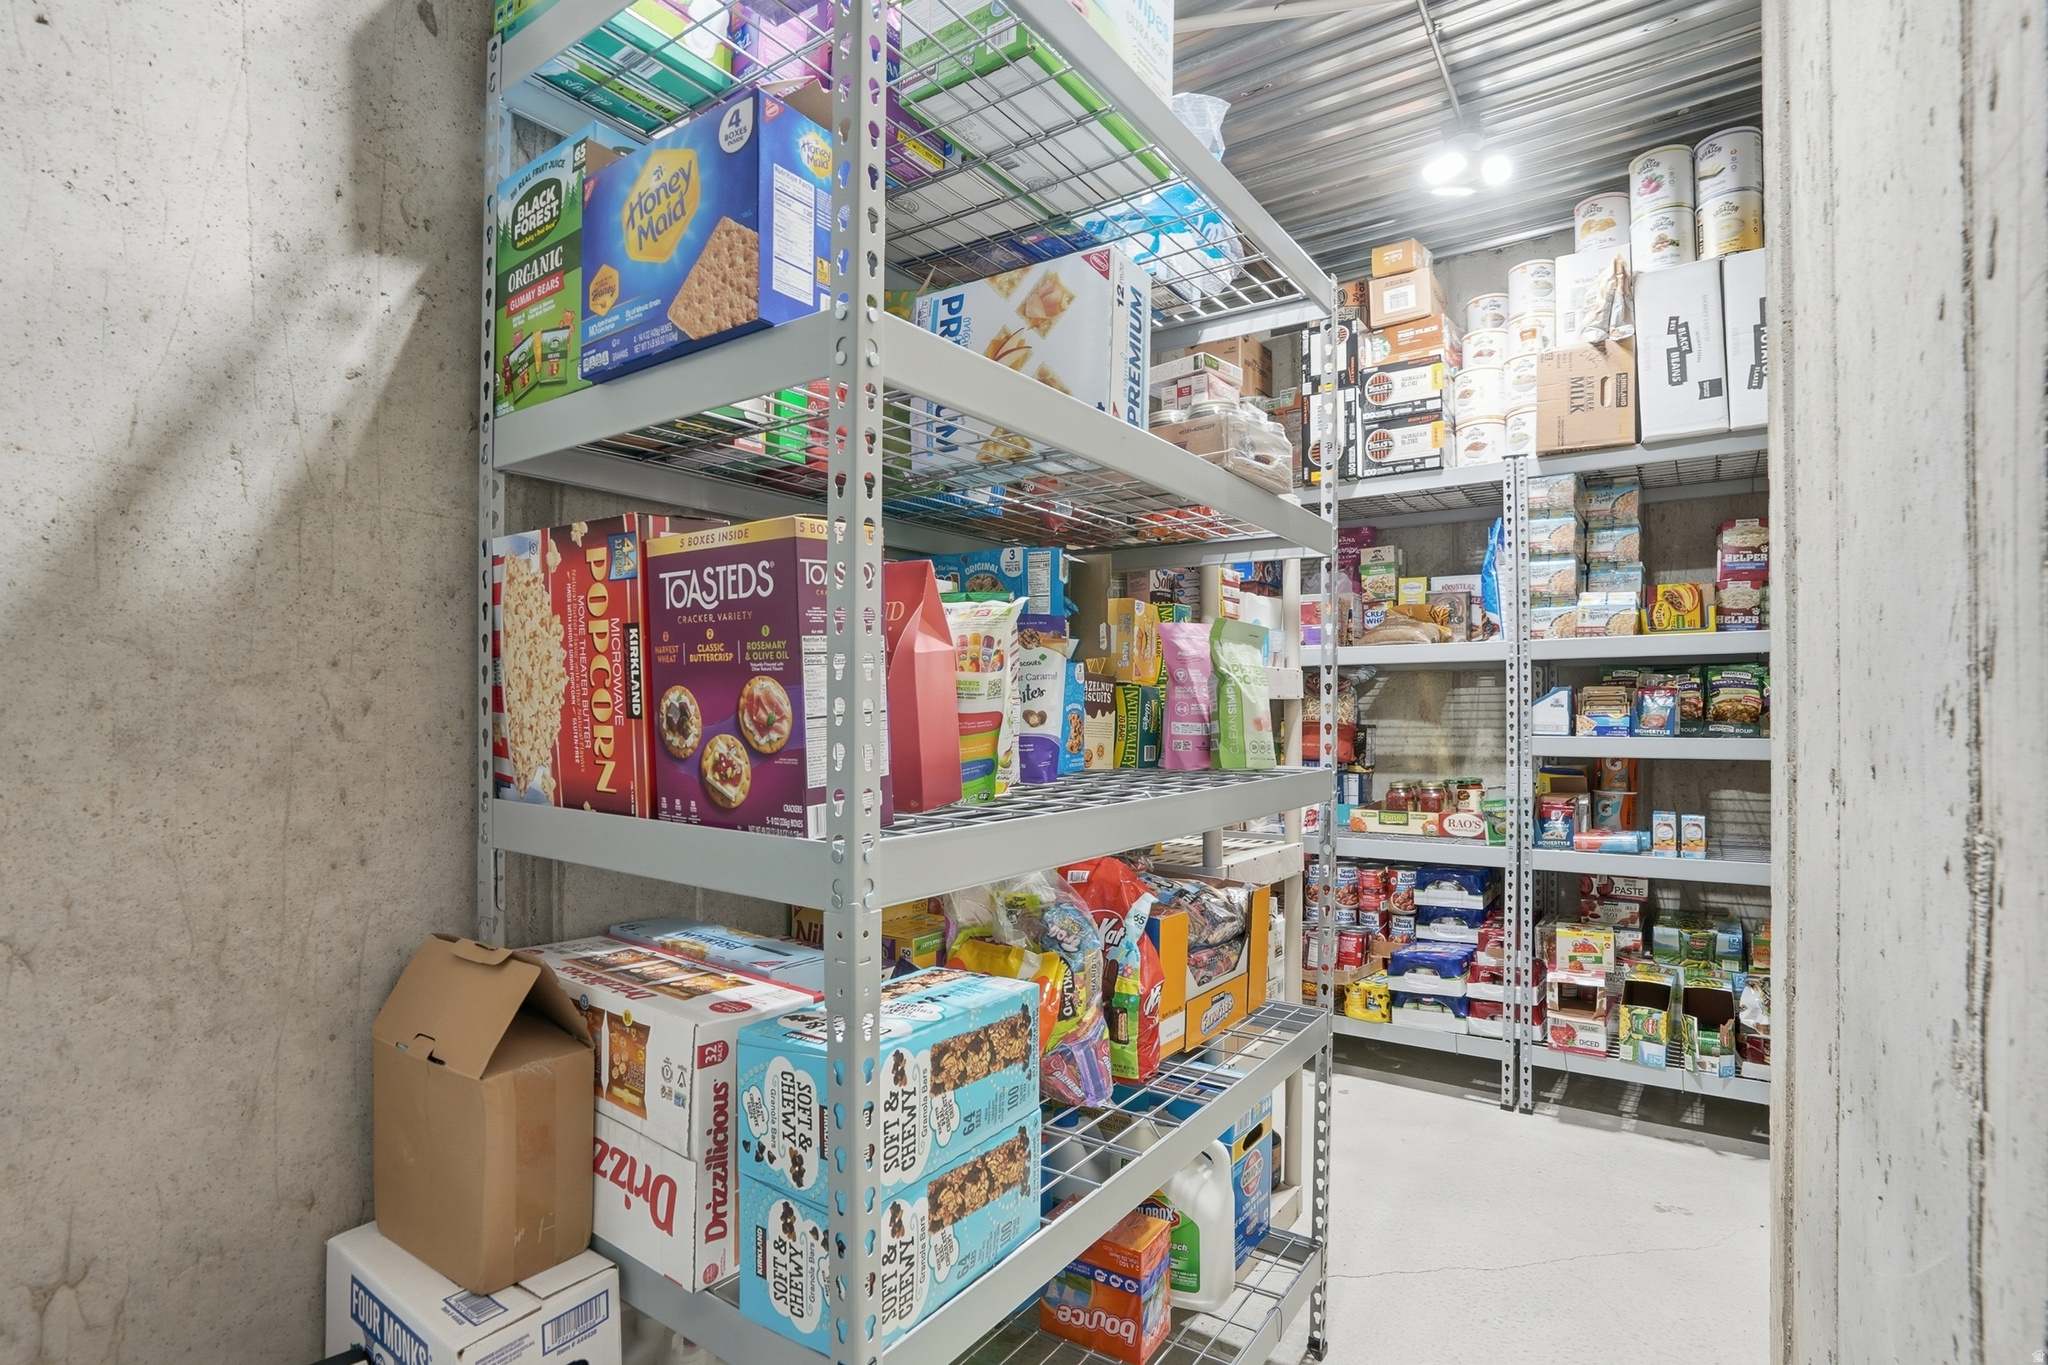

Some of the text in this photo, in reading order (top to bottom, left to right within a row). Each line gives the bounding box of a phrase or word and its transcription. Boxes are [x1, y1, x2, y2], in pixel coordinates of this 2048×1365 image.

[724, 126, 748, 141] BOXES
[727, 108, 742, 129] 4
[574, 143, 586, 162] 65
[801, 139, 832, 161] Honey
[806, 153, 830, 171] Maid
[518, 159, 566, 192] REAL FRUIT JUICE
[517, 184, 556, 222] BLACK
[627, 160, 693, 230] Honey
[636, 199, 687, 251] Maid
[508, 245, 563, 293] ORGANIC
[509, 276, 560, 311] GUMMY BEARS
[1117, 284, 1125, 307] 12
[1677, 327, 1690, 352] BLACK
[1127, 285, 1144, 427] PREMIUM
[1569, 376, 1585, 415] MILK
[679, 528, 749, 548] 5 BOXES INSIDE
[799, 522, 805, 532] 5
[622, 537, 636, 572] 44
[964, 562, 998, 576] ORIGINAL
[1009, 549, 1016, 561] 3
[1724, 553, 1768, 562] HELPER
[570, 569, 578, 601] Natural
[659, 559, 775, 610] TOASTEDS
[677, 611, 753, 624] CRACKER VARIETY
[1716, 615, 1759, 624] HELPER
[654, 645, 679, 654] HARVEST
[657, 654, 676, 663] WHEAT
[689, 653, 734, 663] BUTTERCRISP
[697, 643, 725, 652] CLASSIC
[745, 650, 790, 661] & OLIVE OIL
[746, 641, 787, 650] ROSEMARY
[573, 662, 581, 682] with
[577, 595, 591, 749] MOVIE THEATER BUTTER
[585, 546, 617, 794] POPCORN
[610, 617, 625, 727] MICROWAVE
[629, 628, 641, 716] KIRKLAND
[1025, 672, 1058, 681] Caramel
[576, 708, 584, 740] Natural
[1122, 691, 1139, 768] NATURE VALLEY
[572, 717, 580, 764] GLUTEN-FREE
[783, 804, 803, 814] CRACKERS
[1448, 818, 1482, 830] RAO'S
[1614, 886, 1644, 896] PASTE
[1133, 913, 1145, 925] 65
[1577, 1024, 1599, 1032] ORGANIC
[704, 1041, 717, 1064] 32
[1578, 1039, 1600, 1048] DICED
[780, 1070, 797, 1149] CHEWY
[920, 1067, 929, 1139] Granola Bars
[1007, 1084, 1019, 1112] 100
[769, 1088, 778, 1149] Granola Bars
[796, 1081, 812, 1152] SOFT &
[901, 1086, 917, 1173] CHEWY
[963, 1108, 975, 1137] 64
[883, 1090, 900, 1175] SOFT &
[704, 1080, 731, 1246] Drizzilicious
[999, 1219, 1013, 1247] 100
[756, 1225, 766, 1276] KIRKLAND
[919, 1214, 927, 1285] Granola Bars
[773, 1238, 788, 1307] SOFT &
[790, 1239, 804, 1320] CHEWY
[899, 1236, 915, 1322] CHEWY
[958, 1250, 970, 1280] 64
[882, 1243, 898, 1326] SOFT &
[352, 1280, 382, 1335] FOUR
[382, 1312, 429, 1365] MONKS
[1056, 1303, 1139, 1346] bounce
[557, 1345, 571, 1356] Item
